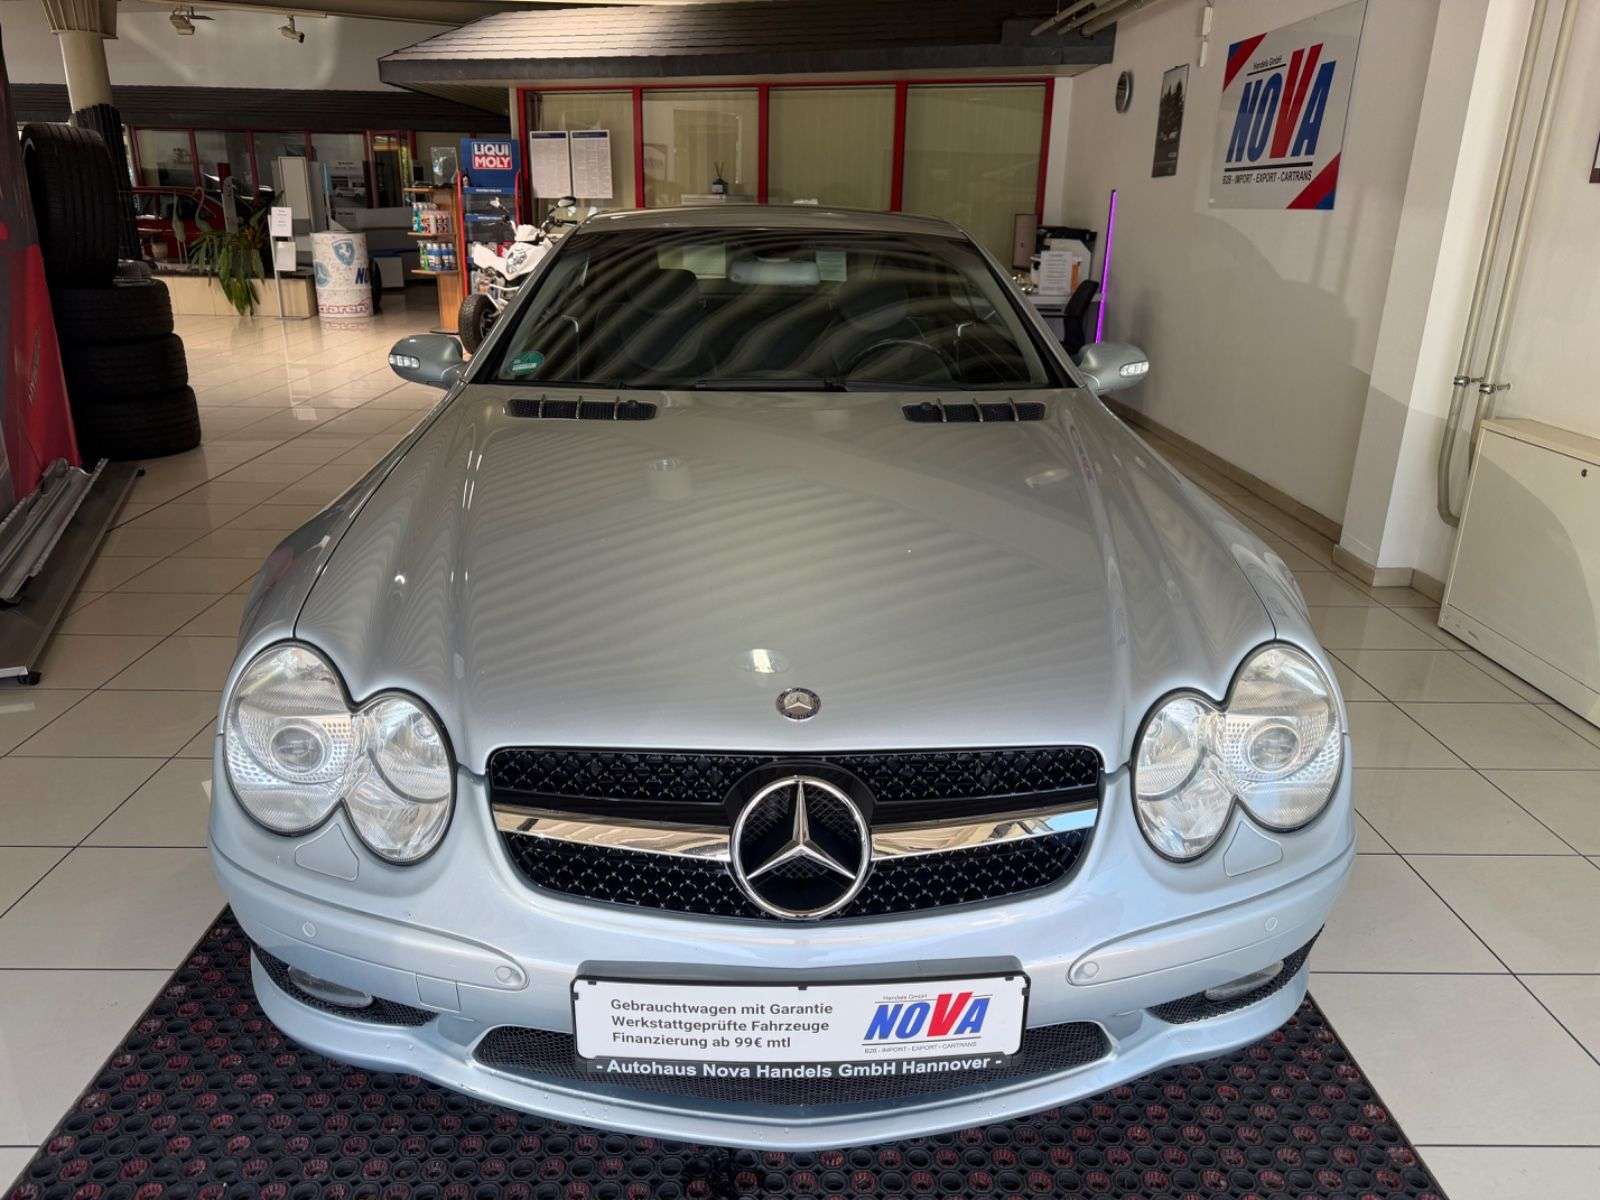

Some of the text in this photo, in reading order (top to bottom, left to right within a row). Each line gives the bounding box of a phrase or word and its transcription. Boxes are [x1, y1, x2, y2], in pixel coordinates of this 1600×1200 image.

[1226, 43, 1337, 163] NOVA
[474, 143, 509, 156] LIQUI
[474, 156, 511, 169] MOLY
[1234, 173, 1253, 184] IMPORT
[1256, 172, 1277, 183] EXPORT
[1281, 169, 1313, 182] CARTRANS
[611, 999, 833, 1016] Gebrauchtwagen mit Garantie
[864, 991, 993, 1041] NOVA
[611, 1015, 830, 1034] Werkstattgeprüfte Fahrzeuge
[612, 1032, 791, 1048] Finanzierung ab 99€ mtl
[881, 1045, 906, 1053] IMPORT
[911, 1043, 937, 1052] EXPORT
[942, 1041, 977, 1049] CARTRANS
[606, 1060, 697, 1077] Autohaus
[703, 1063, 750, 1078] Nova
[757, 1064, 833, 1079] Handels
[838, 1062, 896, 1077] GmbH
[902, 1056, 991, 1075] Hannover
